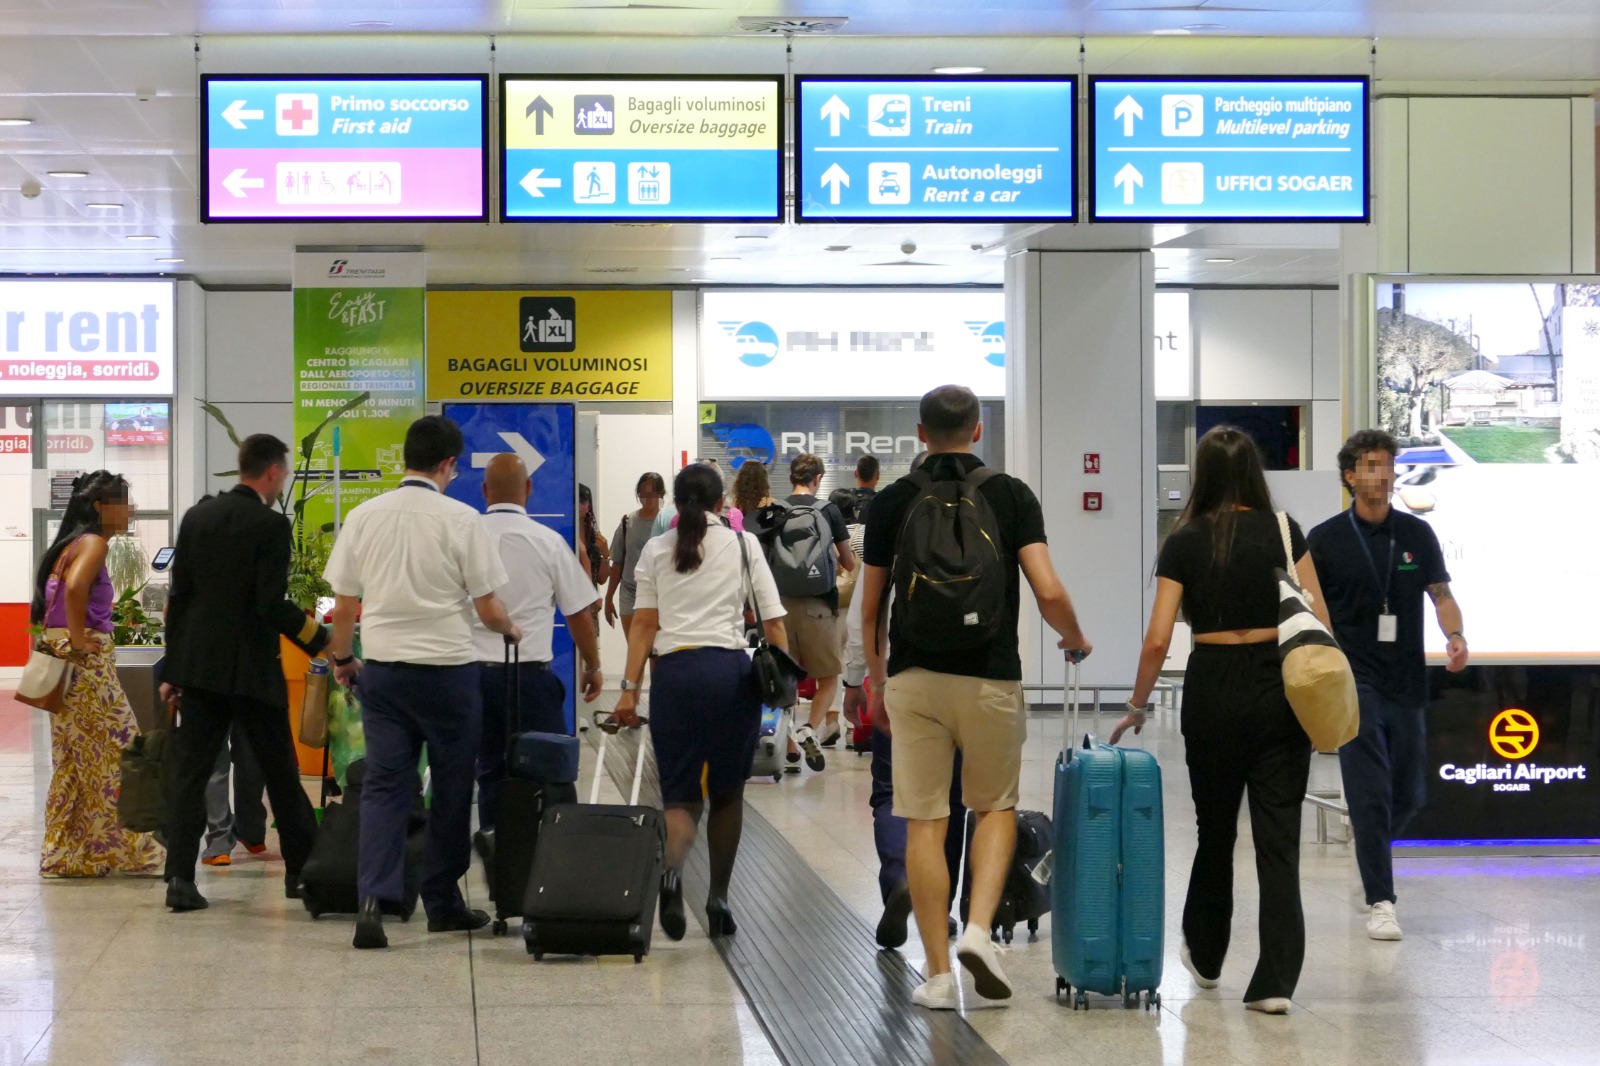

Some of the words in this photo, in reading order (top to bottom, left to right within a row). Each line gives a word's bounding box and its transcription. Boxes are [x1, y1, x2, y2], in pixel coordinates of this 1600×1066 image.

[331, 95, 385, 112] Primo
[390, 98, 470, 112] soccorso
[628, 96, 681, 115] Bagagli
[686, 96, 766, 112] voluminosi
[922, 96, 971, 112] Treni
[1215, 96, 1282, 116] Parcheggio
[1285, 96, 1352, 116] multipiano
[332, 117, 376, 134] First
[379, 117, 412, 134] aid
[594, 115, 608, 124] XL
[925, 118, 973, 134] Train
[1174, 107, 1192, 130] P
[629, 118, 695, 134] Oversize
[699, 118, 767, 138] baggage
[1216, 118, 1292, 135] Multilevel
[1292, 119, 1350, 139] parking
[922, 163, 1043, 184] Autonoleggi
[1216, 175, 1272, 191] UFFICI
[1277, 175, 1353, 191] SOGAER
[923, 186, 969, 203] Rent
[973, 190, 985, 203] a
[990, 190, 1021, 203] car
[328, 291, 376, 320] Easy
[44, 304, 160, 352] rent
[547, 325, 566, 337] XL
[8, 361, 87, 380] noleggia,
[92, 361, 155, 377] sorridi.
[306, 358, 346, 367] CENTRO
[348, 358, 359, 367] DI
[361, 358, 409, 367] CAGLIARI
[447, 357, 528, 372] BAGAGLI
[533, 357, 648, 372] VOLUMINOSI
[391, 370, 415, 378] CON
[301, 381, 352, 390] REGIONALE
[353, 381, 362, 390] DI
[364, 381, 415, 390] TRENITALIA
[459, 381, 545, 396] OVERSIZE
[549, 381, 640, 396] BAGGAGE
[301, 398, 314, 407] IN
[315, 398, 348, 407] MENO
[377, 398, 415, 407] MINUTI
[781, 431, 834, 454] RH
[845, 431, 927, 454] Ren
[1439, 763, 1512, 784] Cagliari
[1514, 763, 1587, 784] Airport
[1493, 784, 1531, 792] SOGAER
